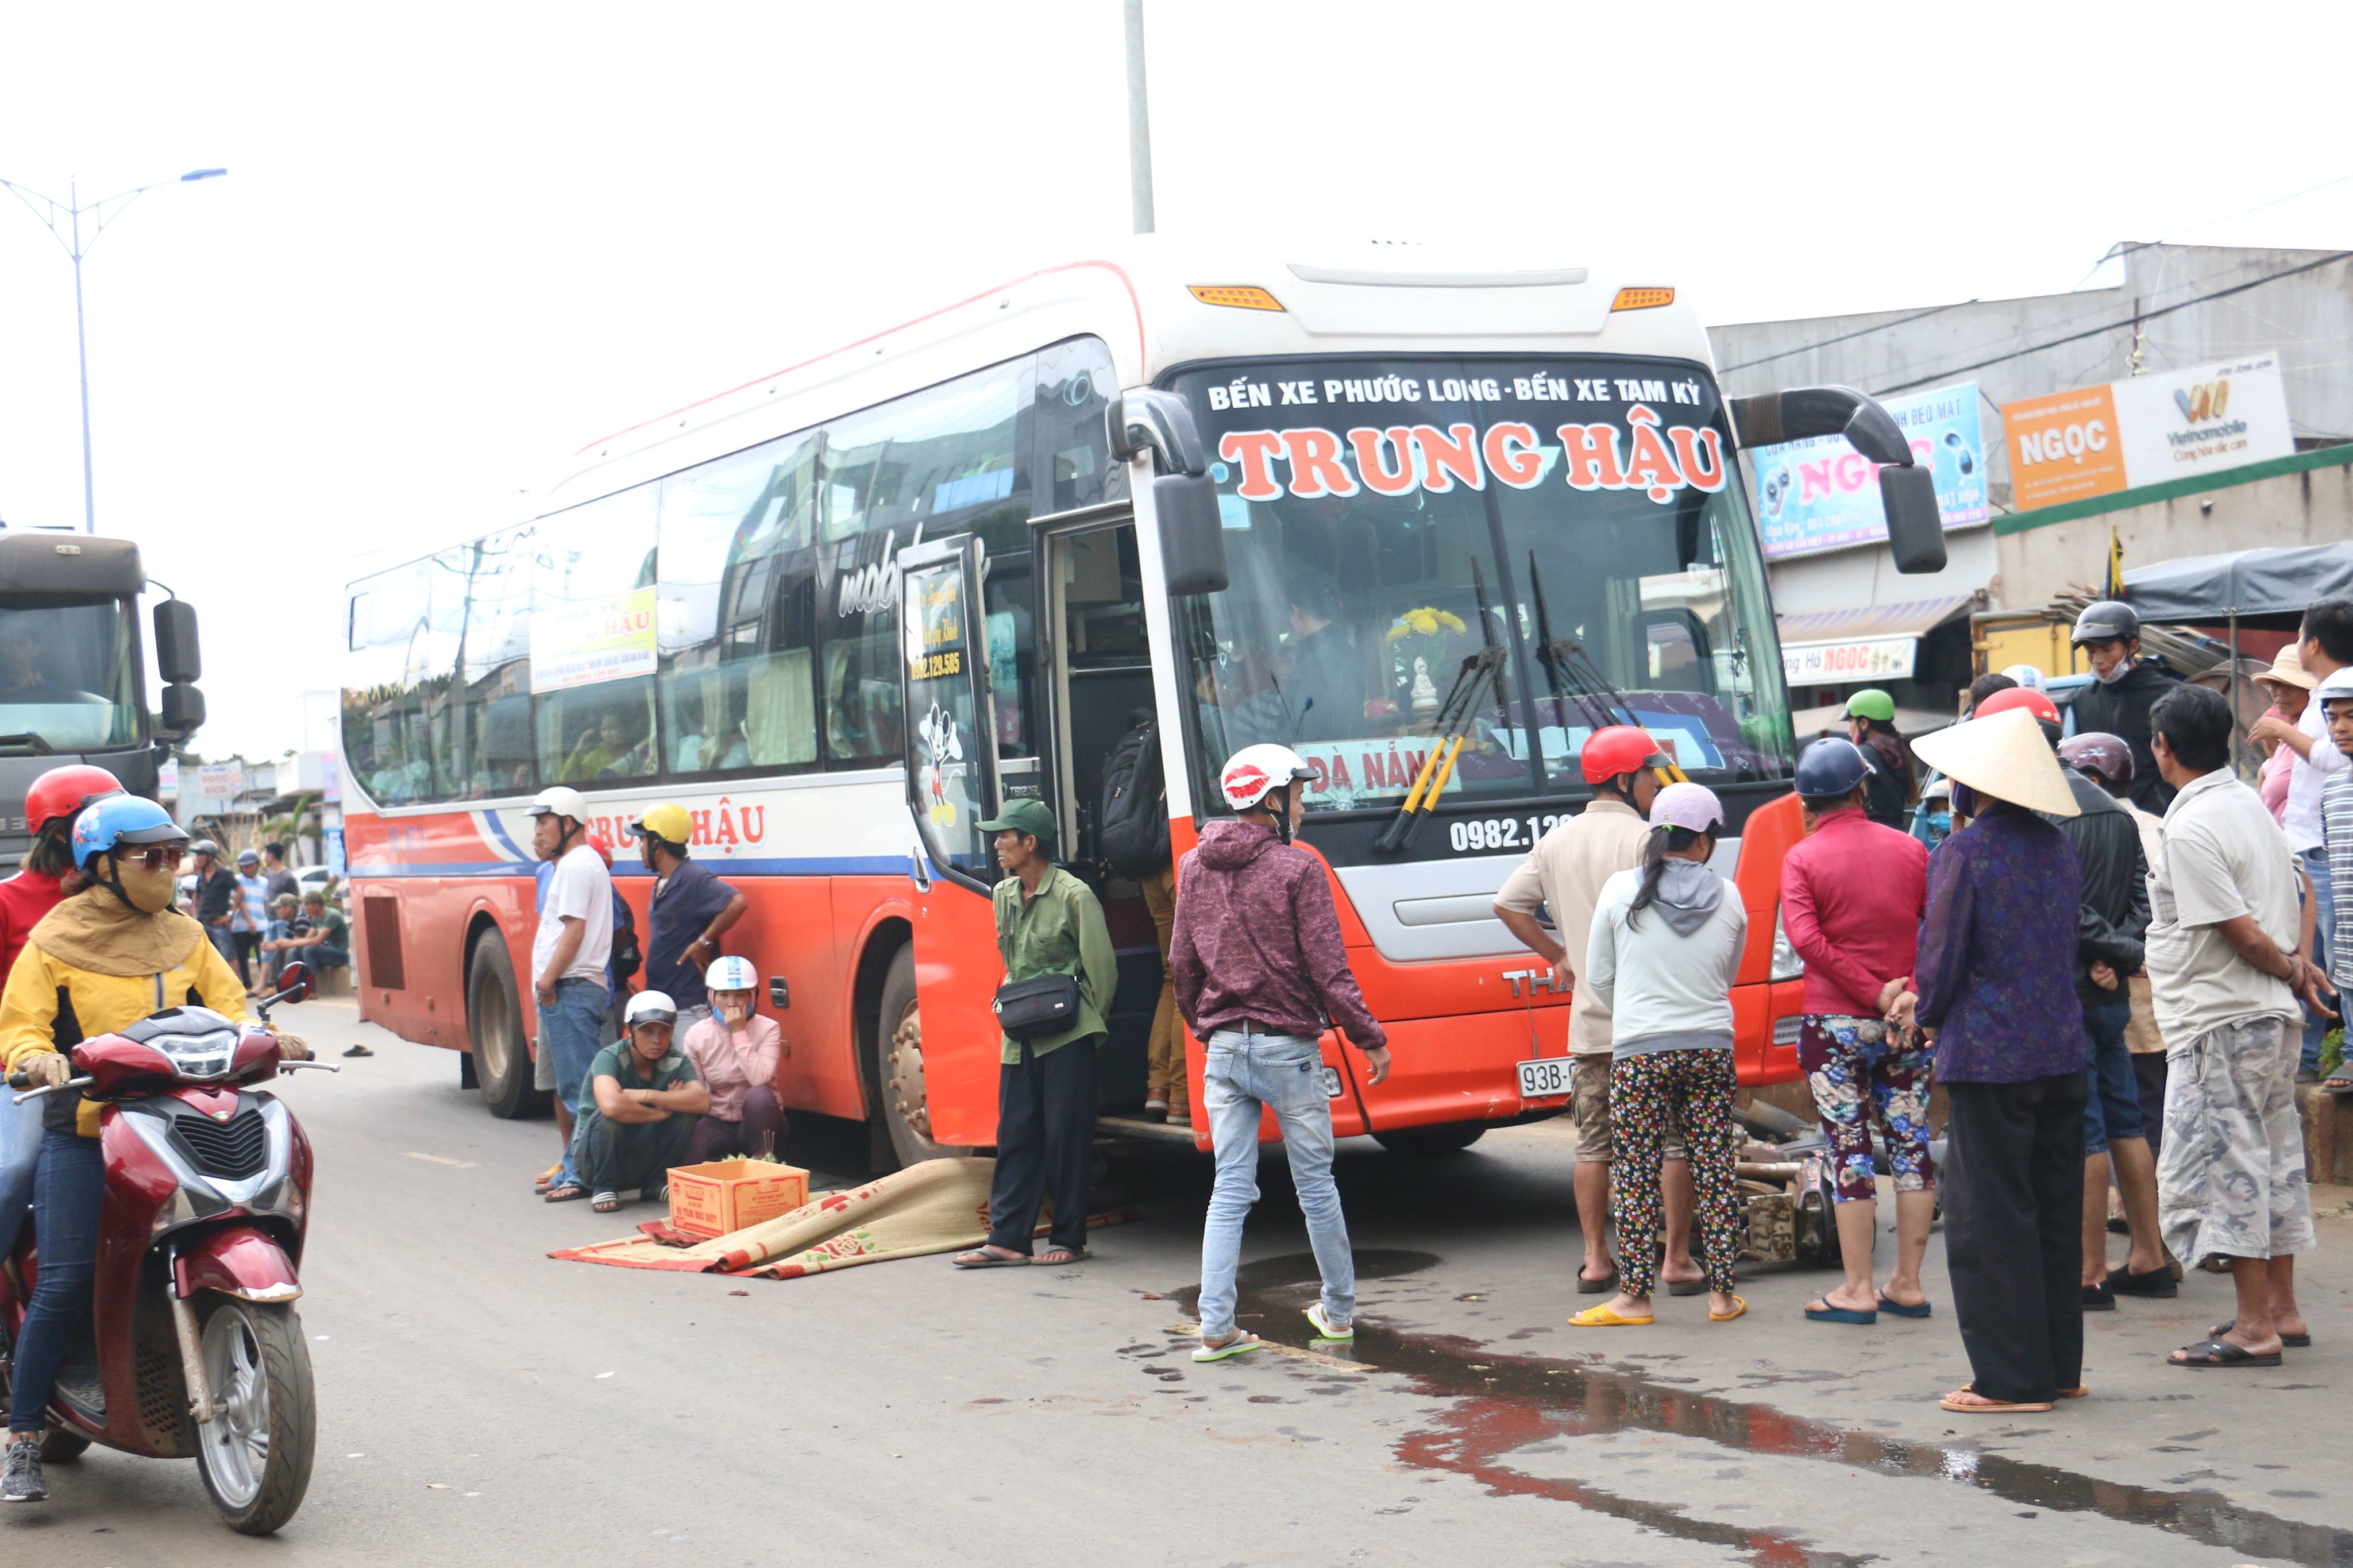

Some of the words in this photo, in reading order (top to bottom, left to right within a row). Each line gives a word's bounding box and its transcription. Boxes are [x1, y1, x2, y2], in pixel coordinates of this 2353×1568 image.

[1208, 376, 1272, 411] BẾN
[1277, 381, 1318, 405] XE
[1323, 374, 1421, 403] PHƯỚC
[1573, 379, 1611, 402] XE
[1614, 380, 1668, 403] TAM
[1671, 378, 1700, 406] KỲ
[1219, 422, 1544, 503] TRUNG
[1556, 403, 1727, 507] HẬU
[2019, 419, 2108, 466] NGỌC
[1783, 655, 1800, 674] ng
[1823, 645, 1870, 675] NGỌC
[689, 796, 765, 854] HẬU
[1502, 967, 1573, 998] TH
